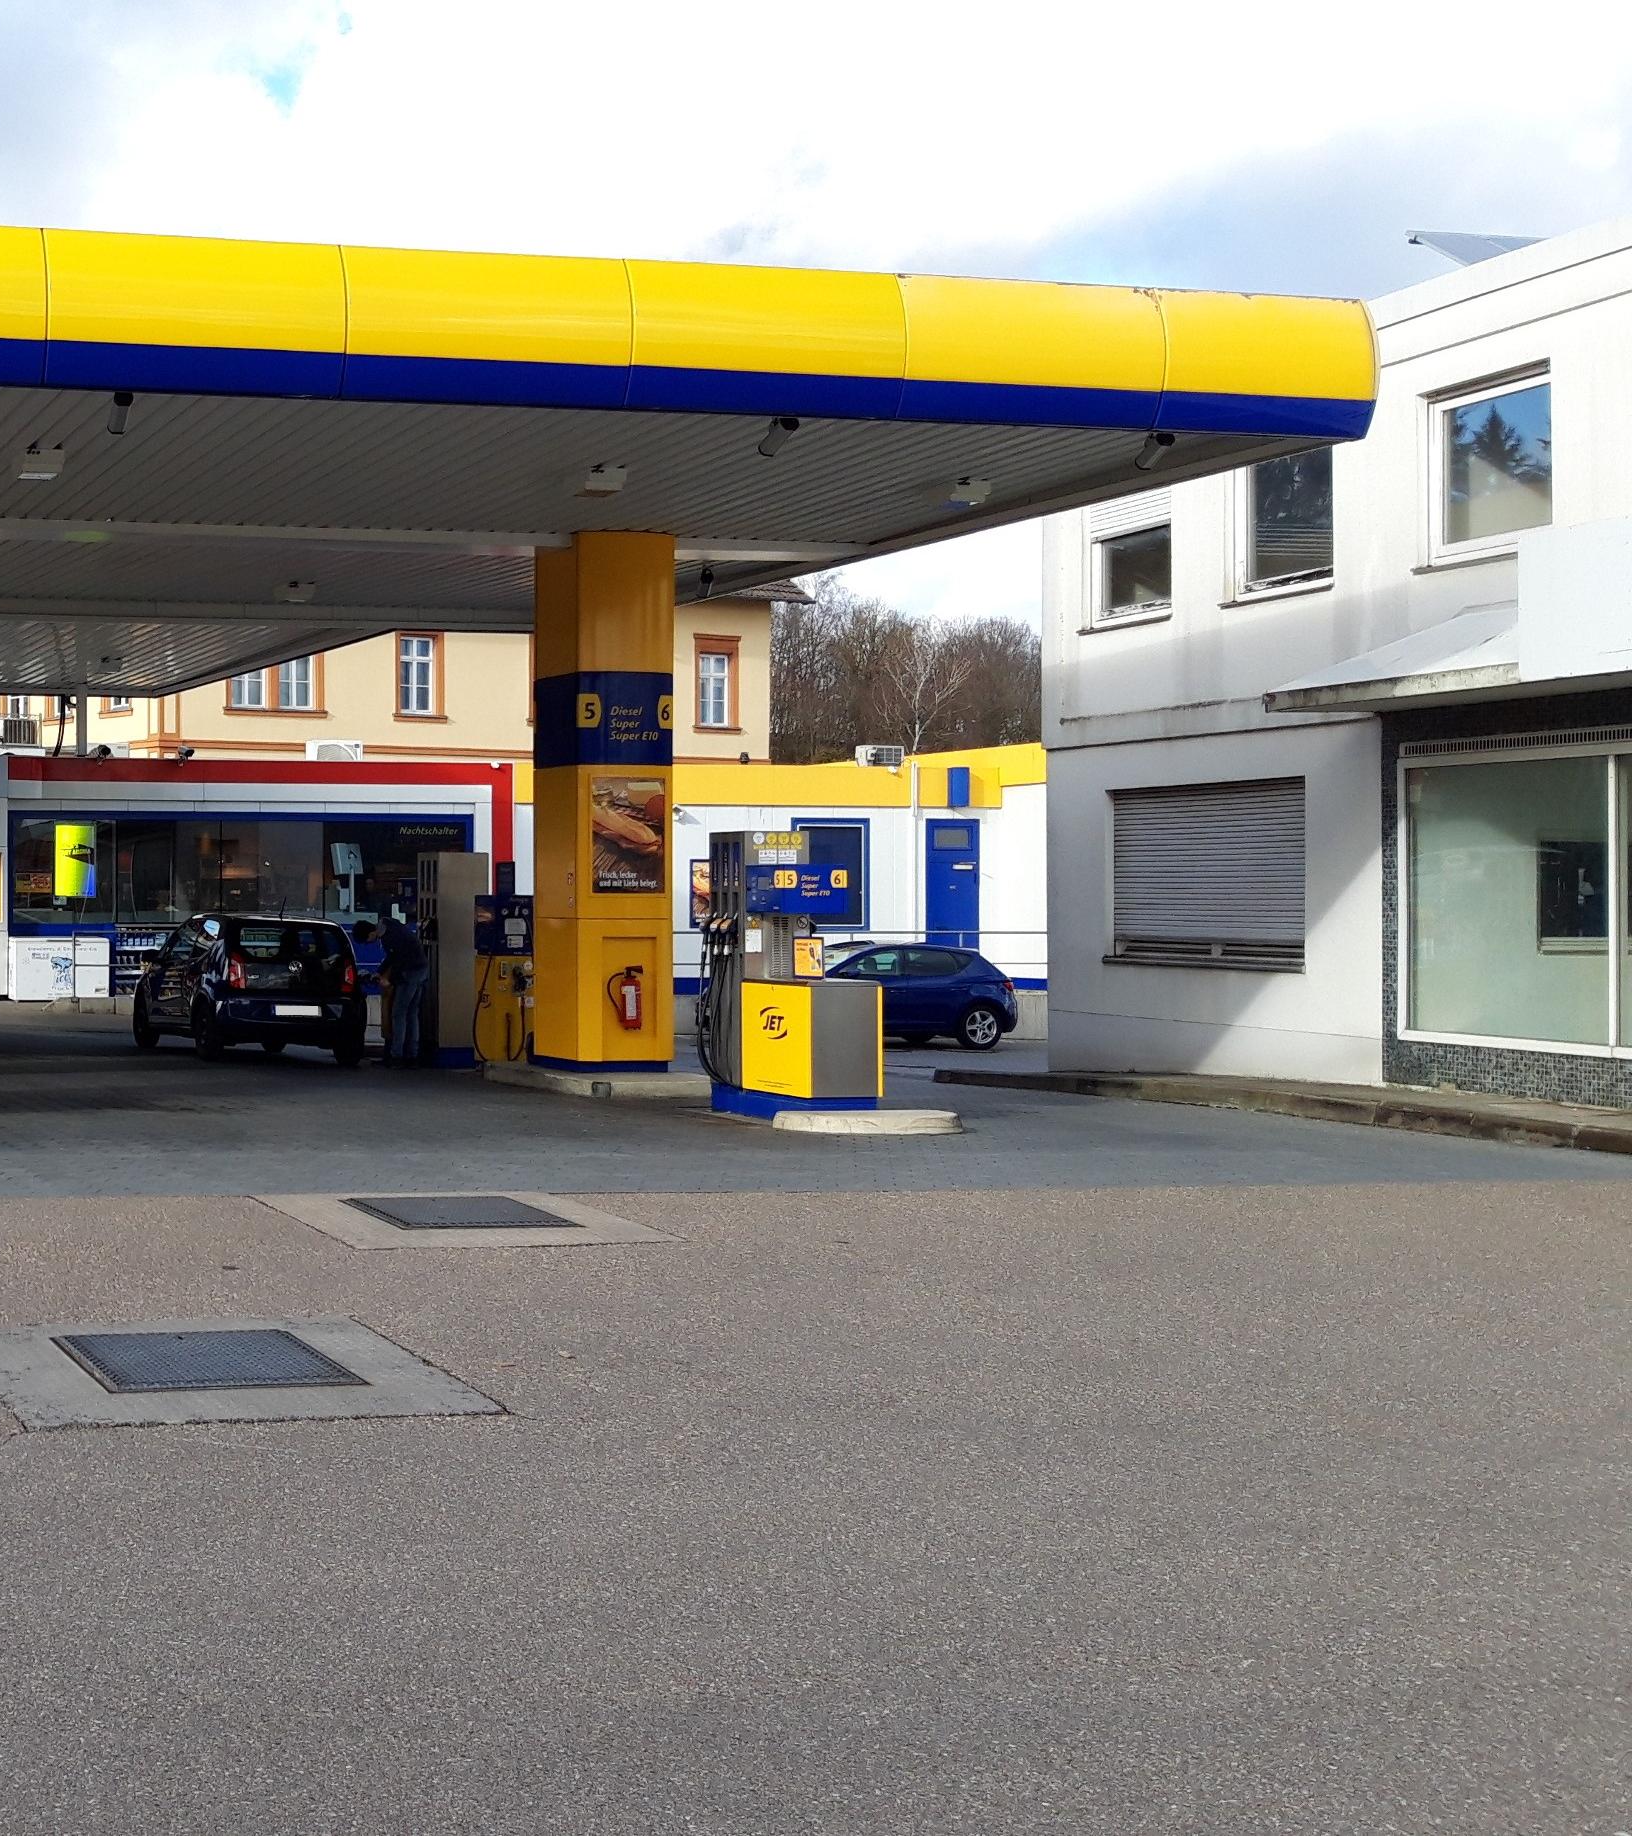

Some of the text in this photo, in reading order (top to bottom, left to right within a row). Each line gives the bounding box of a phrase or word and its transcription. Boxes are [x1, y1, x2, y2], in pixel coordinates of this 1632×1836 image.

[584, 702, 596, 720] 5
[610, 706, 643, 716] Diesel
[661, 704, 670, 721] 6
[609, 719, 640, 730] Super
[609, 731, 659, 742] Super E10
[399, 826, 458, 836] Nachtschalter
[786, 874, 794, 885] 5
[834, 874, 841, 885] 6
[800, 882, 819, 890] Super
[800, 890, 818, 898] Super
[762, 1014, 785, 1031] JET
